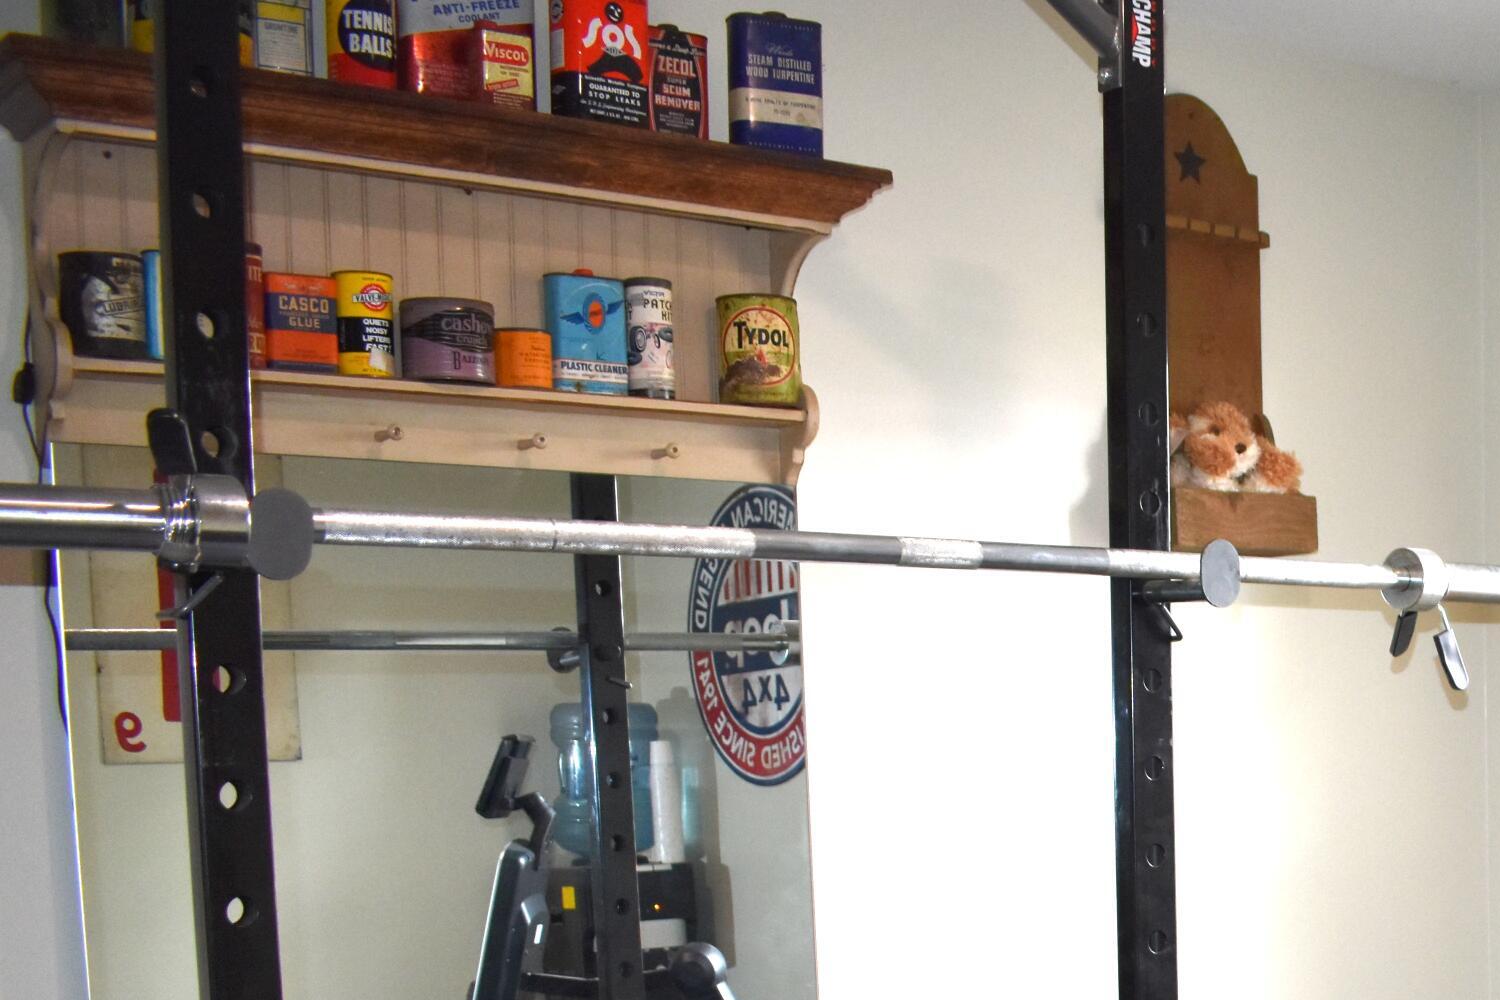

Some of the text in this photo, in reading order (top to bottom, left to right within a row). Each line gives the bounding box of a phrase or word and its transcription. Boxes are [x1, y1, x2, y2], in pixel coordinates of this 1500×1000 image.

[432, 0, 521, 16] ANTI-FREEZE
[342, 9, 393, 36] TENNIS
[458, 12, 501, 24] COOLANT
[581, 17, 642, 60] SOS
[1131, 0, 1152, 68] CHAMP
[349, 33, 393, 59] BALLS
[484, 42, 527, 62] VISCOL
[658, 55, 697, 78] ZECOL
[747, 54, 812, 72] STEAM DISTILLED
[745, 66, 815, 85] WOOD TURPENTINE
[588, 83, 641, 99] GUARANTEED TO
[588, 91, 641, 107] STOP LEAKS
[662, 84, 692, 98] SCUM
[654, 93, 701, 111] REMOVER
[278, 295, 330, 314] CASCO
[289, 316, 321, 329] GLUE
[366, 327, 388, 335] NOISY
[733, 320, 790, 349] TYDOL
[560, 361, 629, 375] PLASTIC CLEANER
